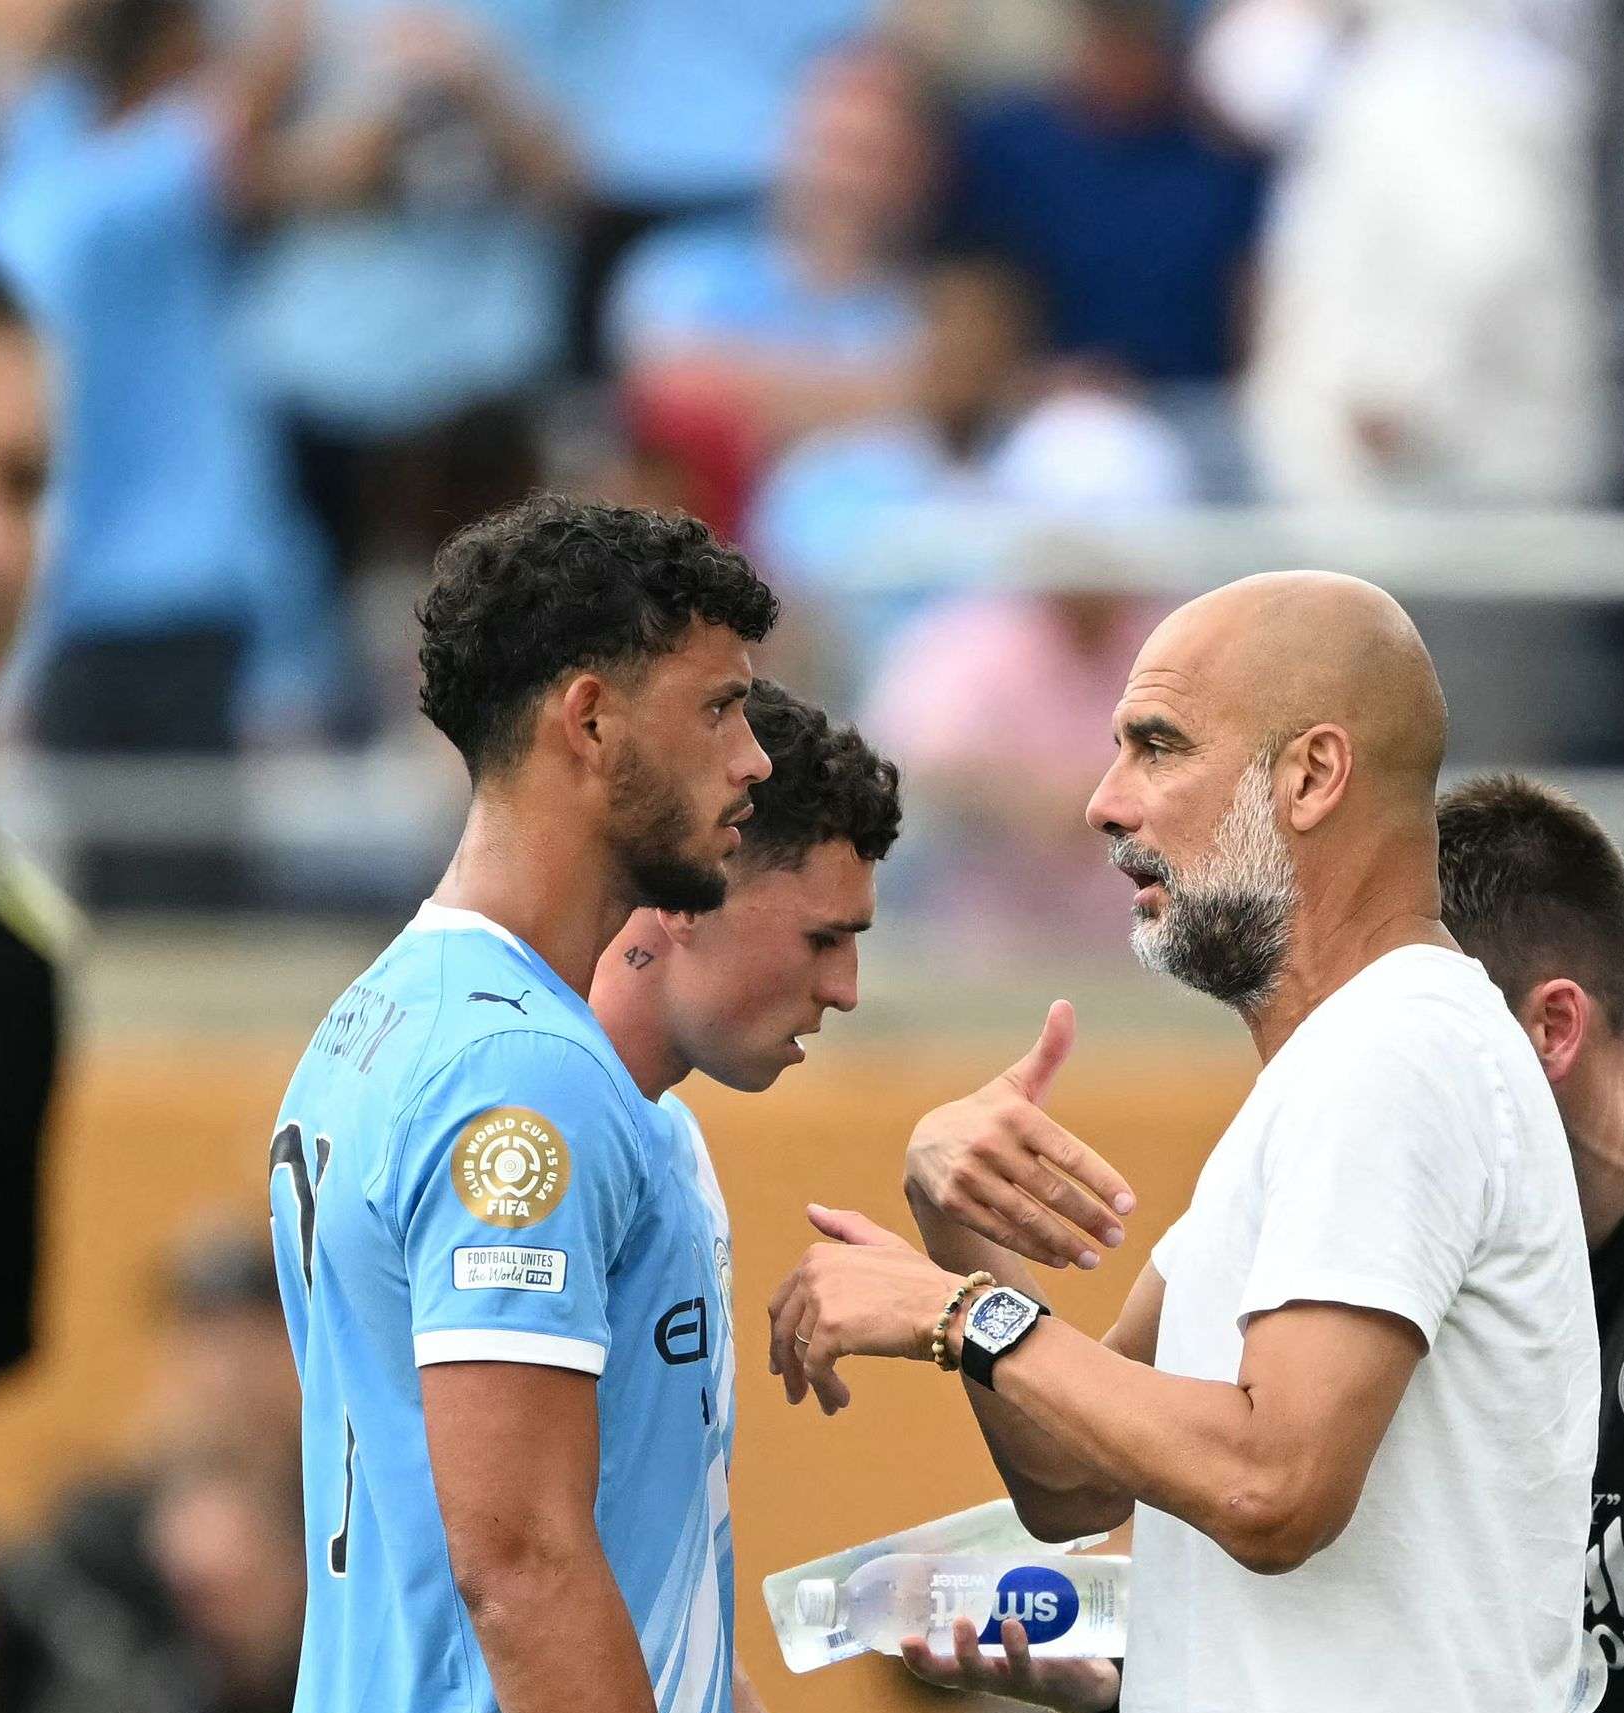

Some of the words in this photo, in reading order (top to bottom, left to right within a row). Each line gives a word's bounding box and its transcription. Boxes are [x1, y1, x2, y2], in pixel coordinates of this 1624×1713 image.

[624, 946, 654, 970] 47
[465, 1117, 516, 1154] WORLD
[520, 1120, 549, 1143] CUP
[544, 1146, 559, 1166] 25
[463, 1159, 483, 1199] CLUB
[535, 1171, 558, 1201] USA
[486, 1199, 530, 1217] FIFA
[467, 1251, 518, 1265] FOOTBALL
[520, 1252, 553, 1268] UNITES
[488, 1265, 524, 1284] World
[526, 1270, 552, 1285] FIFA
